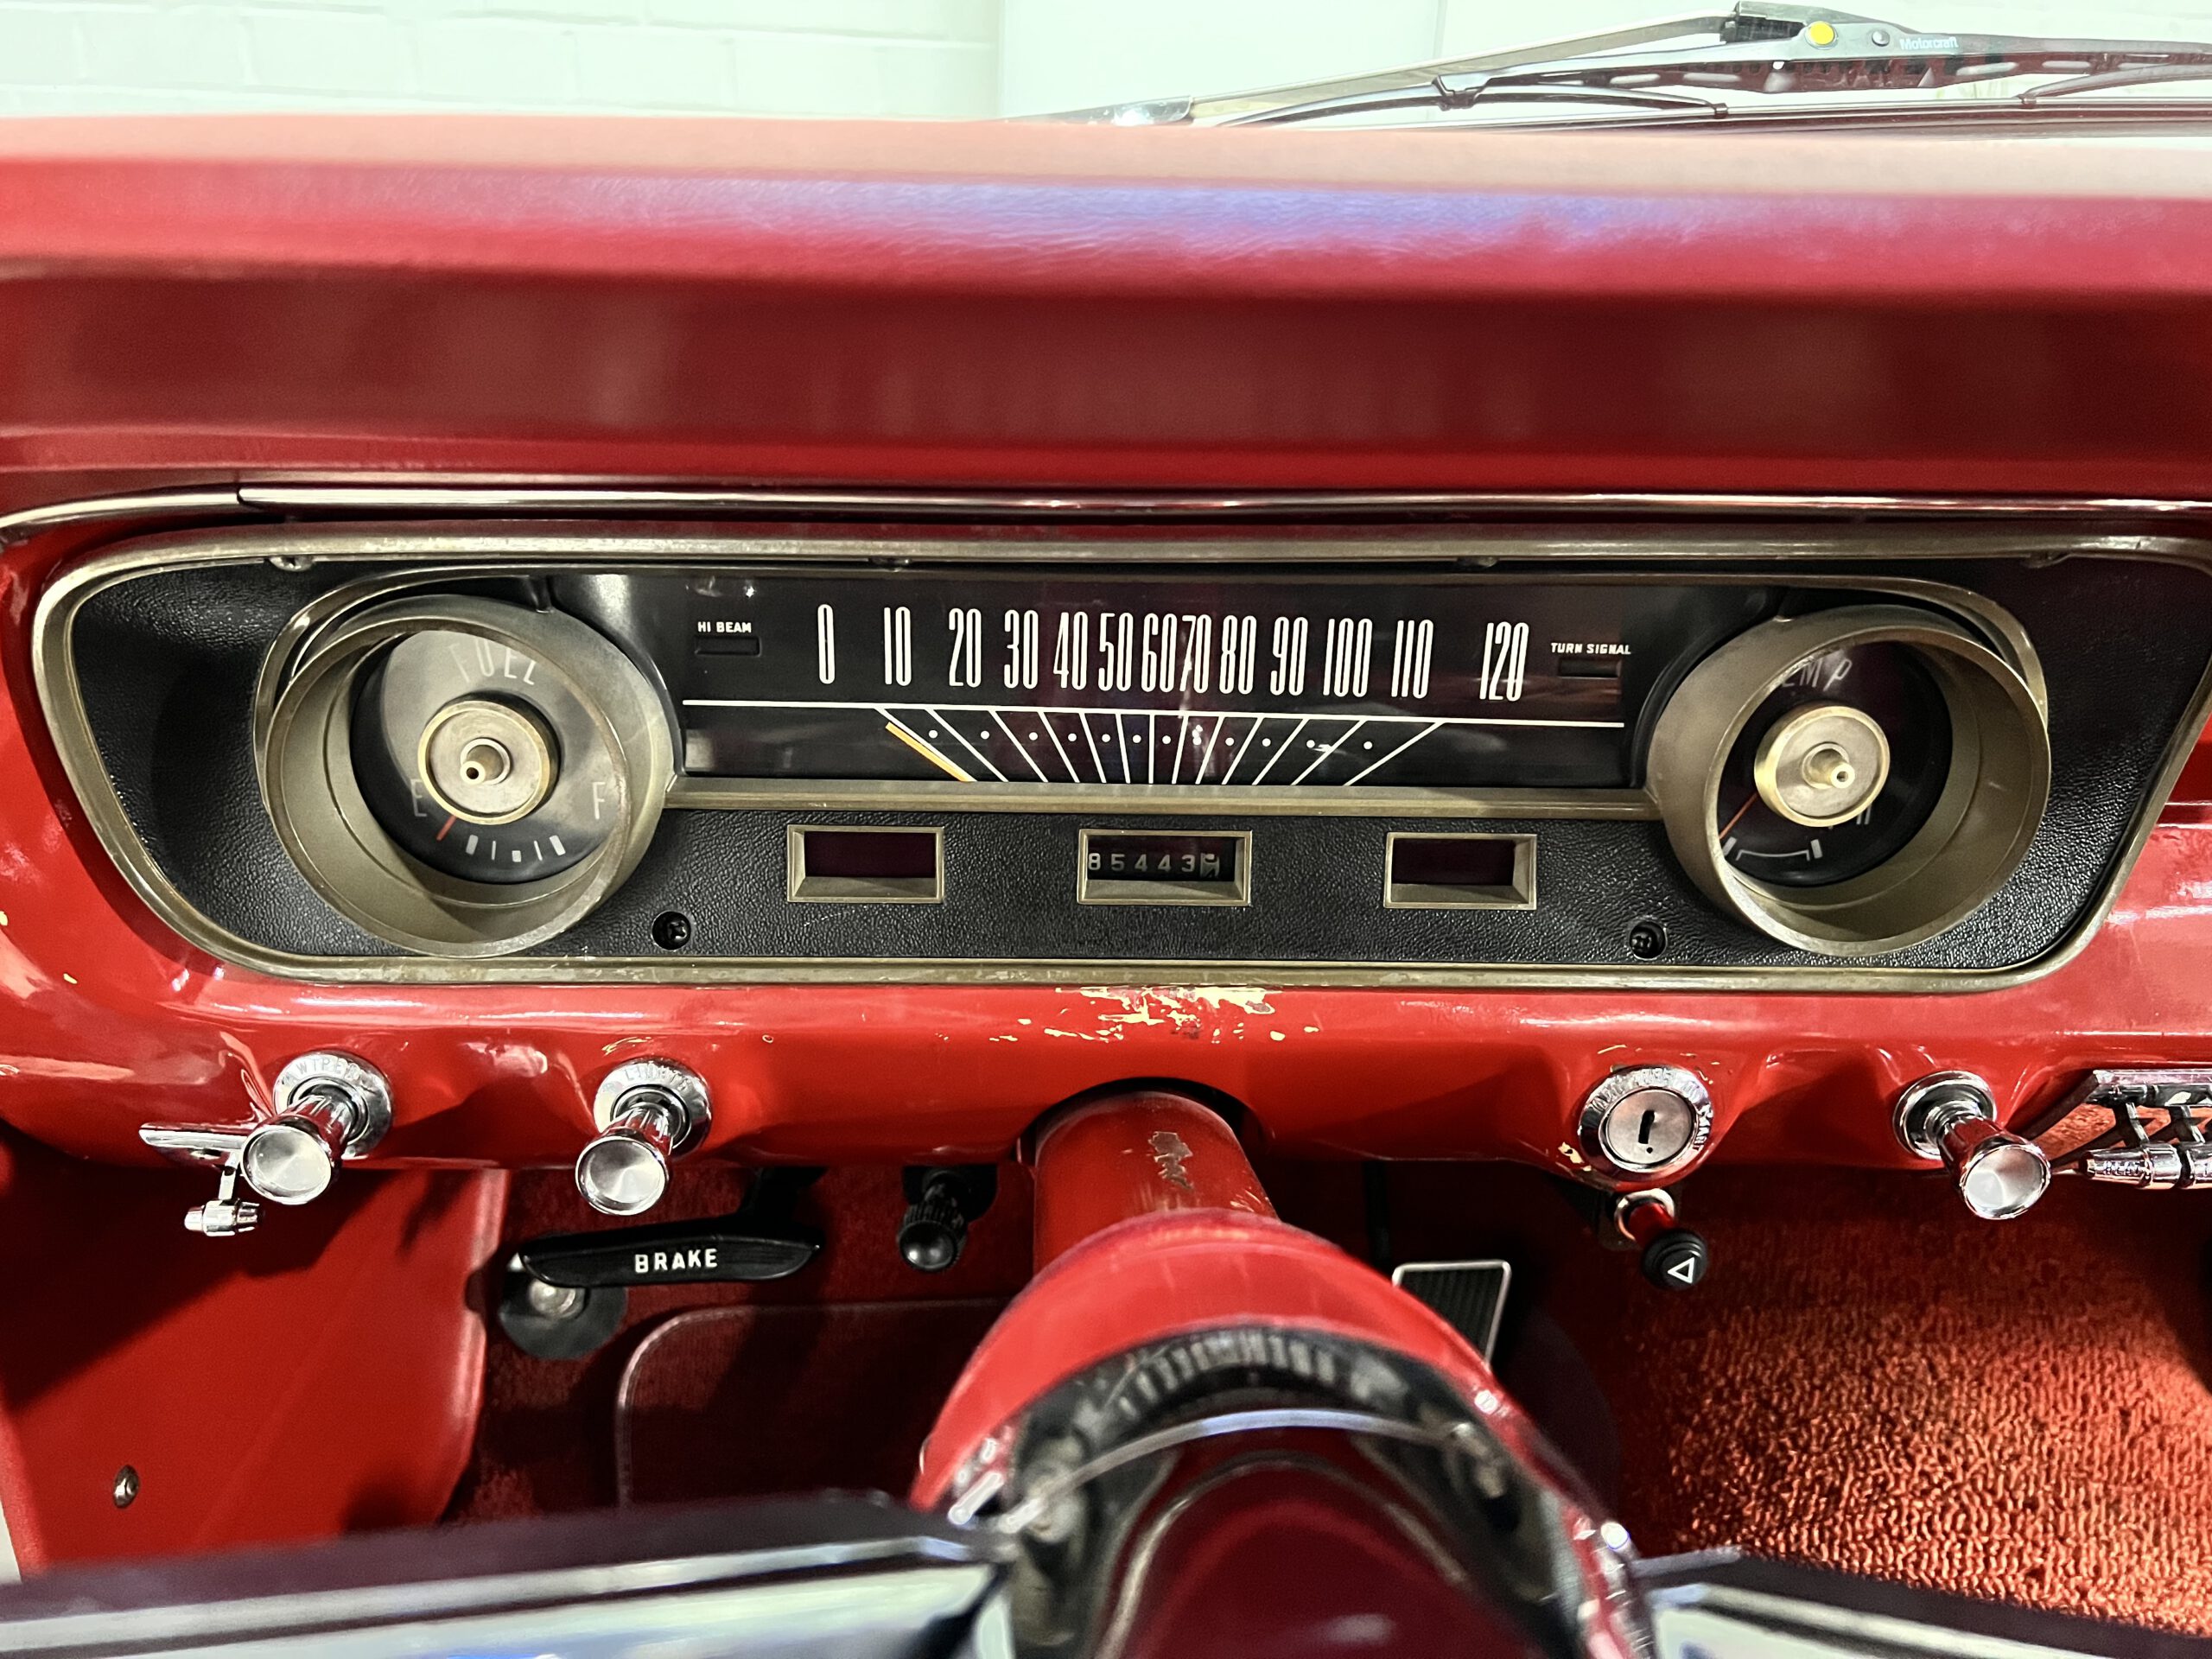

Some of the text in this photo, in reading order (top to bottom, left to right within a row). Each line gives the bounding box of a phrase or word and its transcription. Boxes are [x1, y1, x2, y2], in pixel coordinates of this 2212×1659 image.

[1899, 36, 1959, 50] Motorcraft
[697, 621, 752, 633] HI BEAM
[817, 604, 1529, 702] 0 10 20 30 40 50 60 70 80 90 100 110 120
[1550, 642, 1631, 655] TURN SIGNAL
[410, 779, 427, 817] E
[592, 781, 606, 820] F
[634, 1248, 718, 1274] BRAKE
